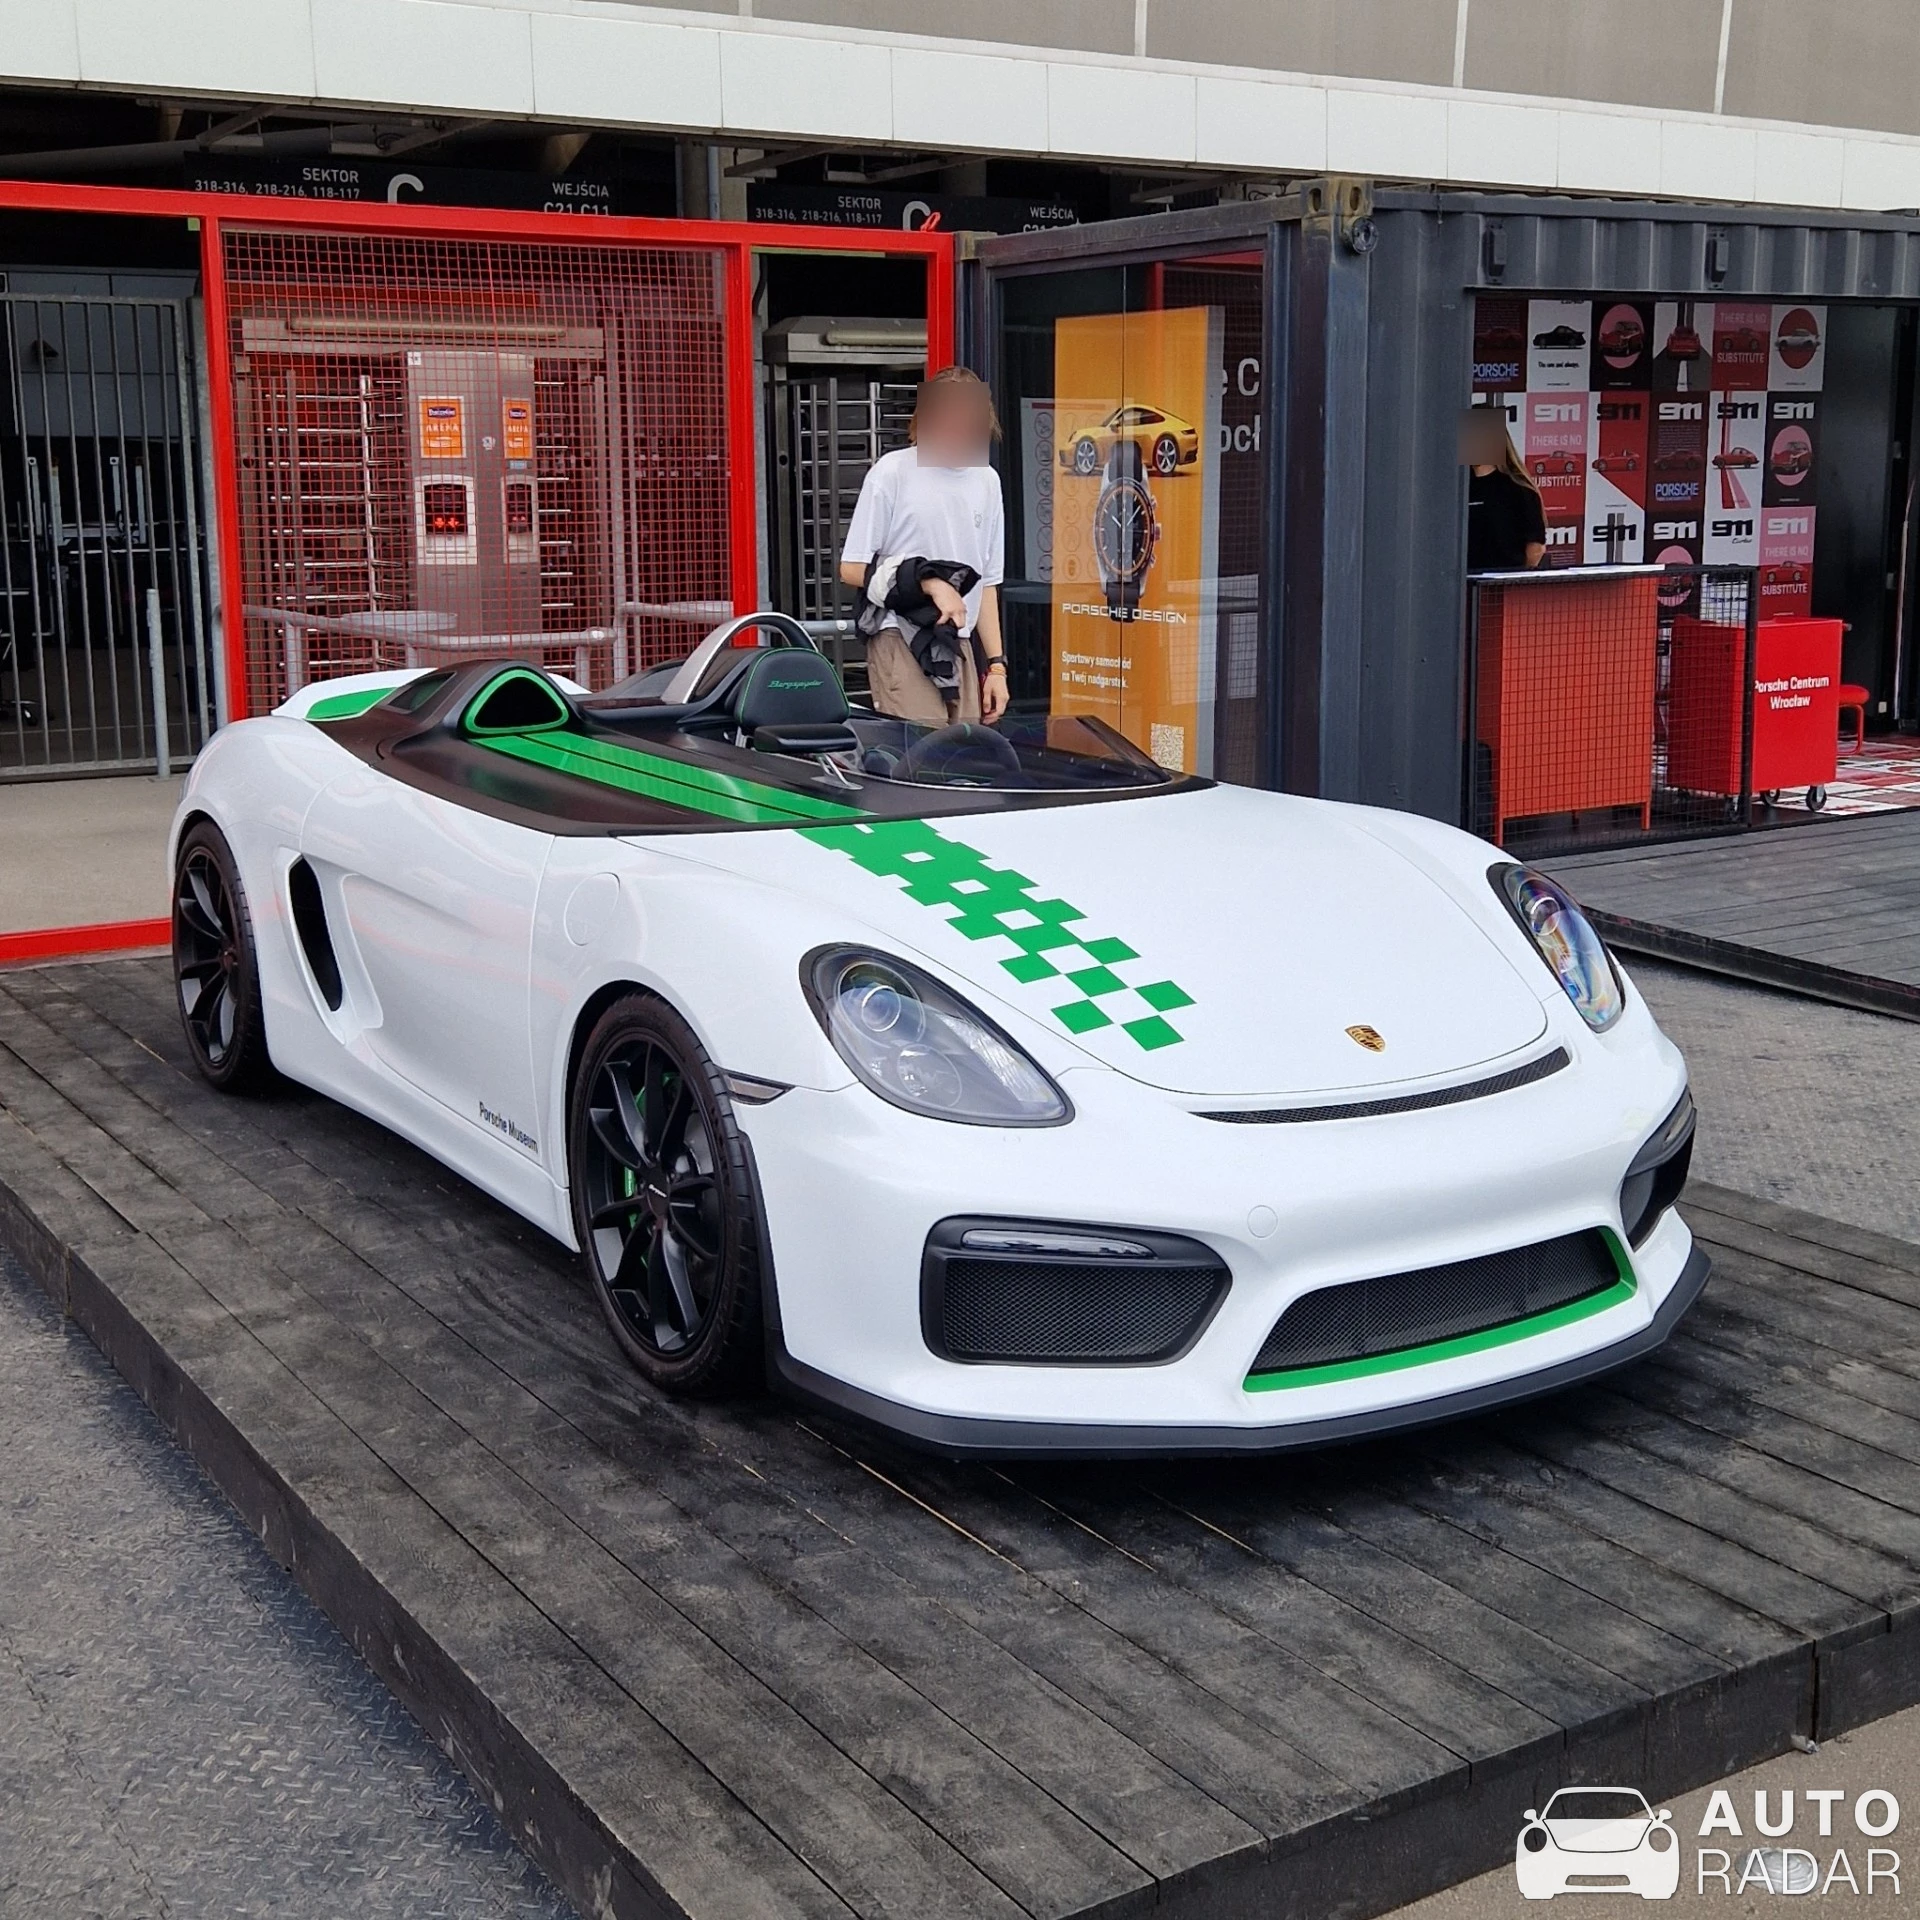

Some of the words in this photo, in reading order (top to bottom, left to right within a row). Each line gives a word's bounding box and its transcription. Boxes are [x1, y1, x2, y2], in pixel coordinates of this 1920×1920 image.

[302, 167, 359, 183] SEKTOR
[194, 179, 249, 195] 318-316,
[255, 183, 308, 197] 218-216,
[312, 186, 360, 199] 118-117
[552, 180, 609, 197] WEJŚCIA
[837, 196, 882, 209] SEKTOR
[755, 208, 797, 221] 318-316,
[802, 210, 842, 223] 218-216,
[845, 212, 882, 224] 118-117
[1029, 204, 1074, 219] WEJŚCIA
[1720, 312, 1745, 324] THERE
[1717, 352, 1765, 363] SUBSTITUTE
[1472, 363, 1519, 377] PORSCHE
[1534, 403, 1581, 422] 911
[1596, 403, 1642, 421] 911
[1659, 402, 1703, 420] 911
[1717, 402, 1759, 419] 911
[1773, 401, 1815, 419] 911
[1532, 434, 1558, 446] THERE
[1560, 434, 1568, 445] IS
[1570, 434, 1582, 445] NO
[1532, 475, 1582, 488] UBSTITUTE
[1655, 482, 1699, 497] PORSCHE
[1593, 524, 1637, 542] 911
[1653, 521, 1697, 540] 911
[1711, 519, 1754, 537] 911
[1767, 517, 1809, 535] 911
[1765, 546, 1787, 557] THERE
[1761, 583, 1808, 596] SUBSTITUTE
[1062, 602, 1128, 618] PORSCHE
[1132, 608, 1187, 624] DESIGN
[1061, 650, 1095, 668] Sportowy
[1790, 676, 1829, 690] Centrum
[1770, 694, 1811, 710] Wrocław
[479, 1100, 507, 1133] Porsche
[508, 1119, 538, 1154] Museum
